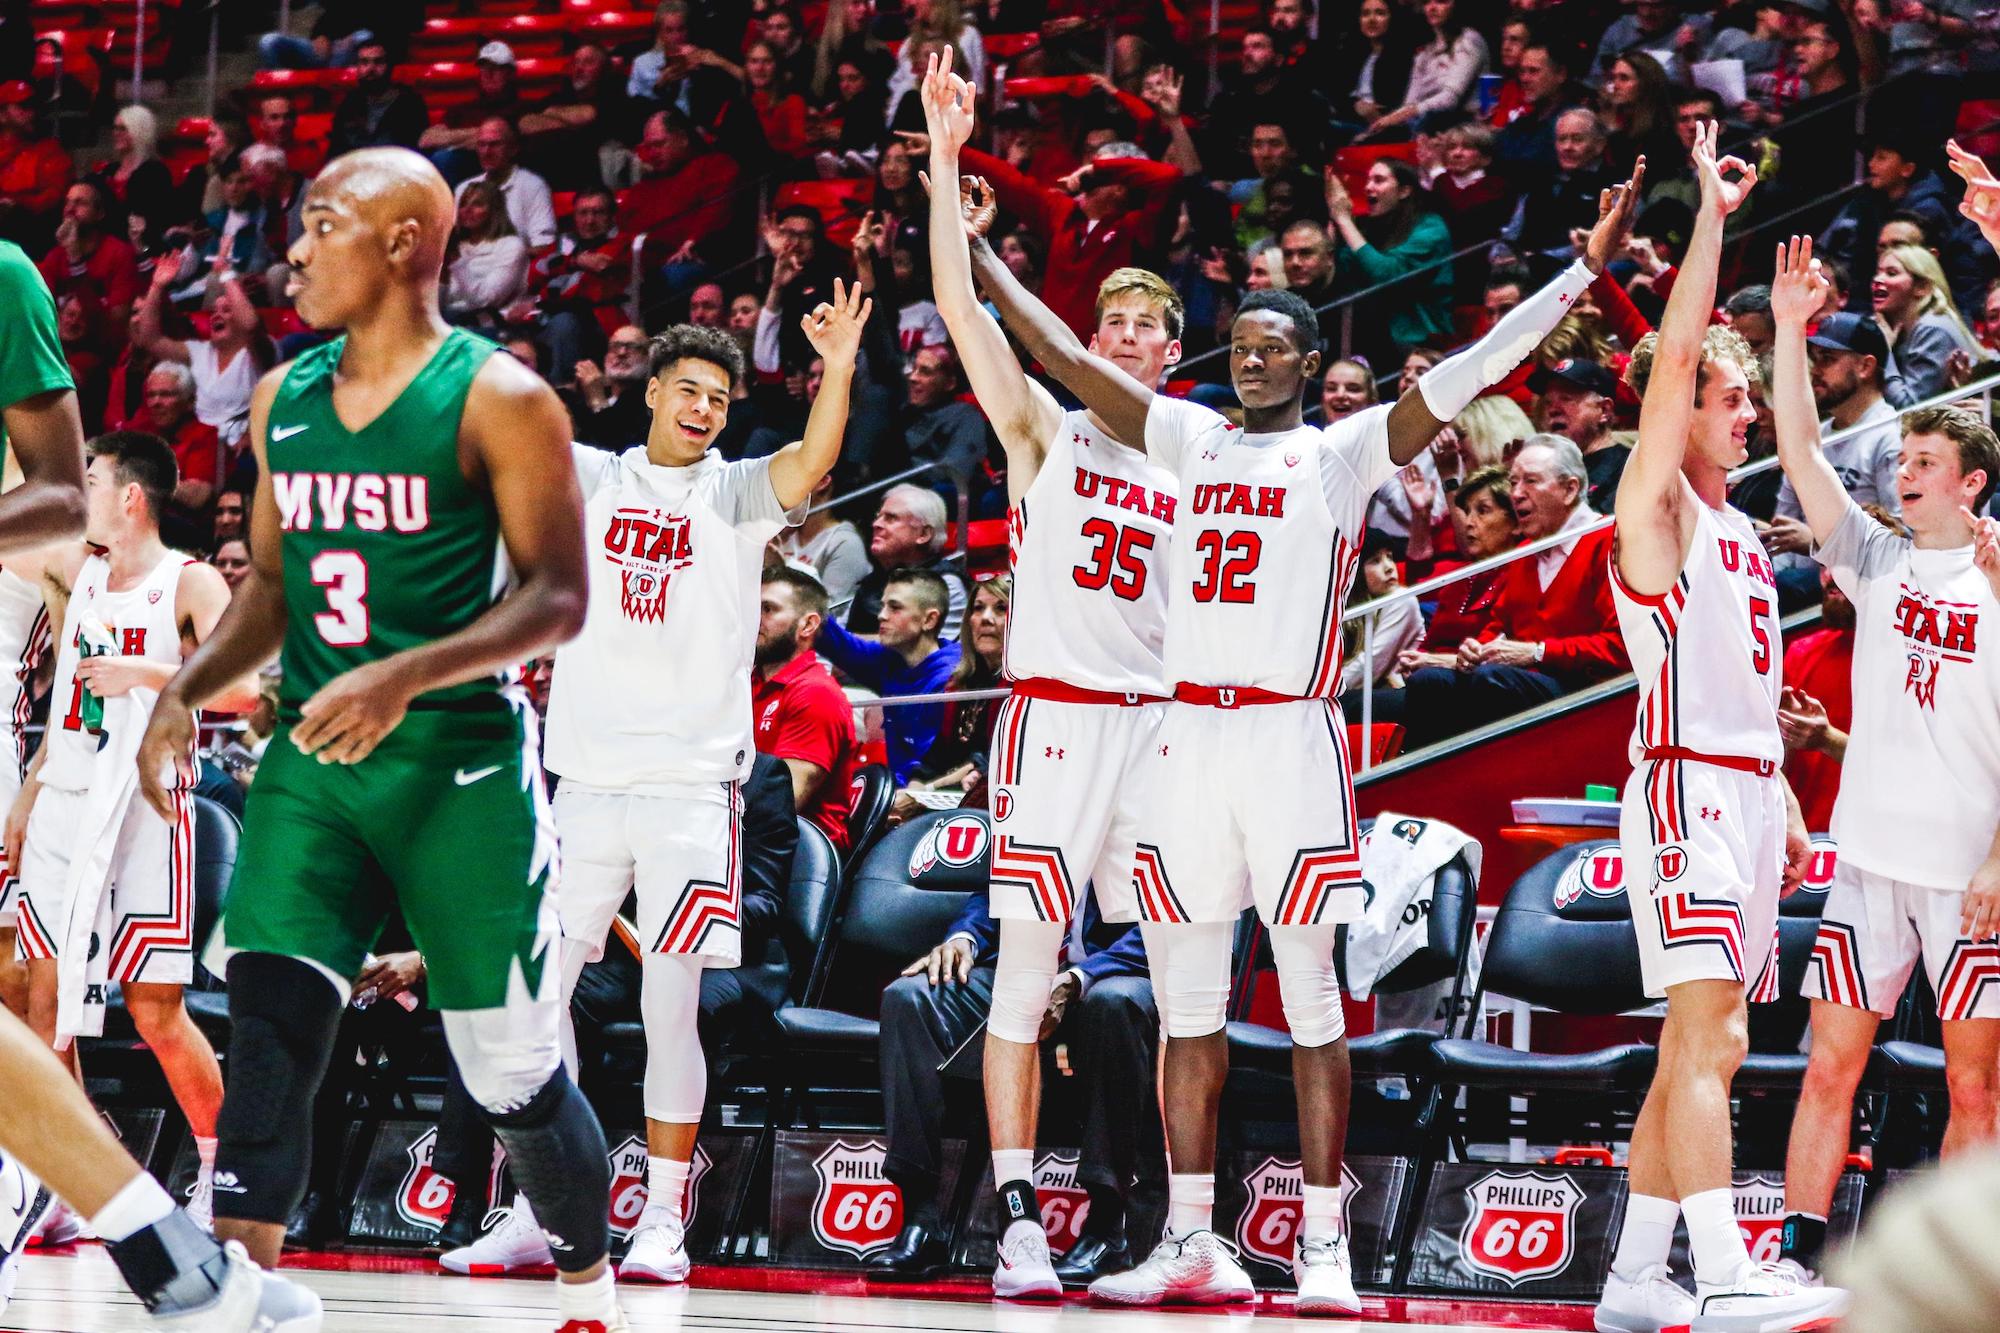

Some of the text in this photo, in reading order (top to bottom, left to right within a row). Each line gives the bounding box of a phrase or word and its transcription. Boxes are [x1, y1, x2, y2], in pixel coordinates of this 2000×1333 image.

[272, 473, 430, 533] MVSU
[1074, 466, 1178, 525] UTAH
[1192, 483, 1287, 518] UTAH
[1072, 517, 1155, 602] 35
[1192, 529, 1262, 604] 32
[310, 549, 370, 648] 3
[1749, 595, 1770, 675] 5
[1218, 688, 1236, 707] U
[995, 795, 1009, 819] U
[946, 826, 982, 860] U
[1593, 857, 1624, 889] U
[1660, 852, 1682, 878] U
[833, 1160, 886, 1180] PHILL
[418, 1174, 456, 1210] 6
[1486, 1185, 1566, 1208] PHILLIPS
[834, 1191, 897, 1232] 66
[1482, 1217, 1556, 1259] 66
